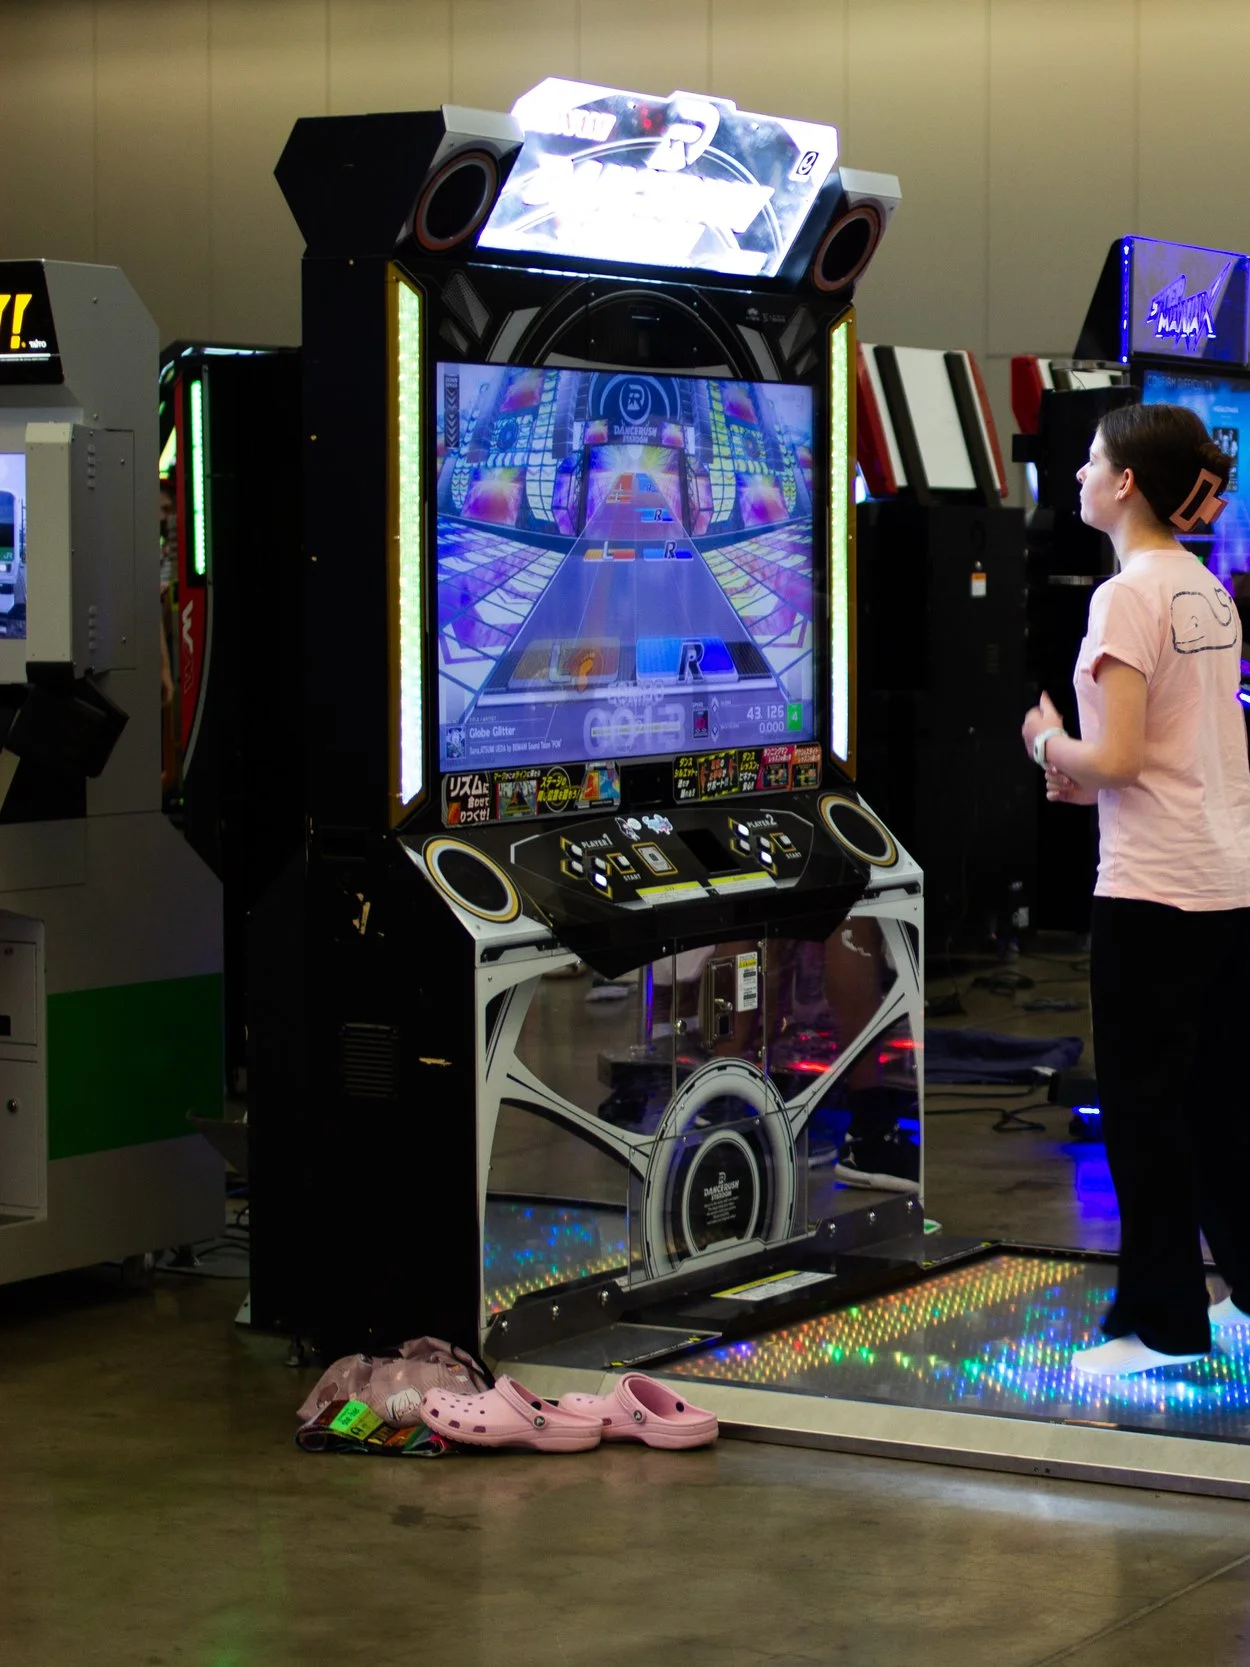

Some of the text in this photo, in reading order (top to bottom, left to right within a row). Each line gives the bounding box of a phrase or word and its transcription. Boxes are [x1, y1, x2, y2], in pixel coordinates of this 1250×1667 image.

[613, 425, 658, 437] DANCERUSH
[603, 540, 677, 560] L R
[549, 638, 705, 683] L R
[469, 725, 516, 738] Globe Glitter
[759, 721, 784, 733] 0.000
[450, 775, 490, 797] リズムに
[623, 873, 641, 881] START
